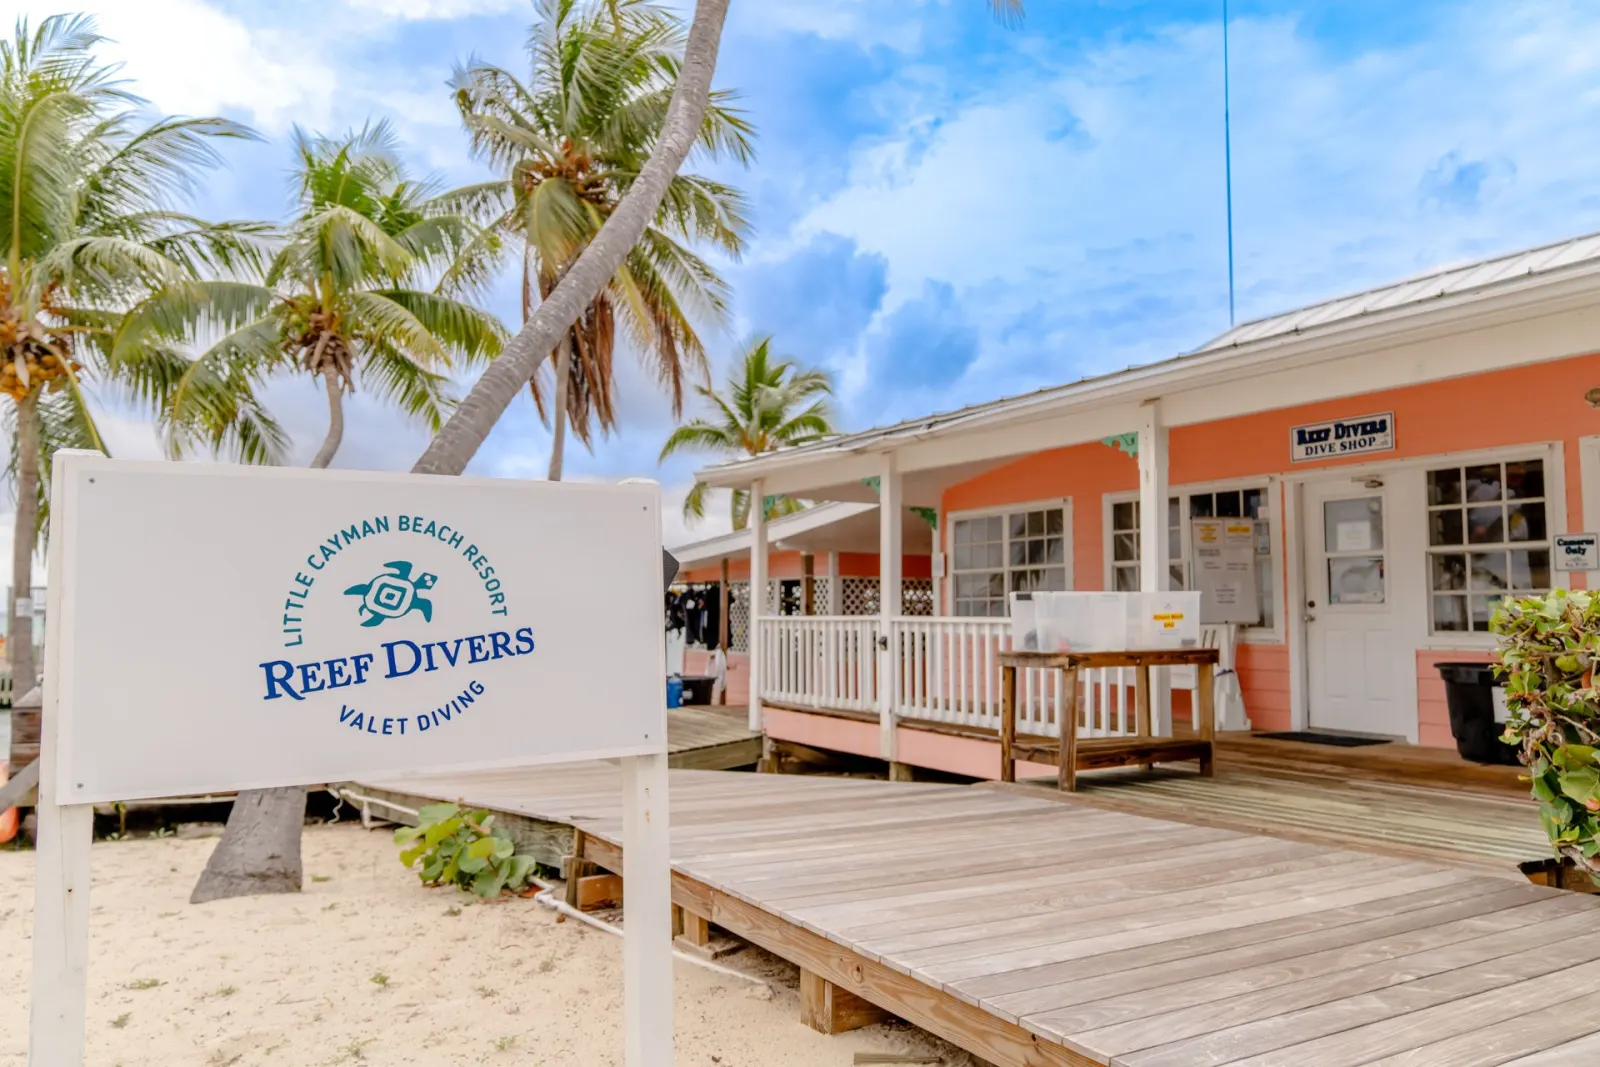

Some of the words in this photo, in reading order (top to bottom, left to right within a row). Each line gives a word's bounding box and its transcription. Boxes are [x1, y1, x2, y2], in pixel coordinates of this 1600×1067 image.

[1305, 443, 1337, 456] DIVE
[1340, 436, 1376, 451] SHOP
[283, 572, 314, 647] LITTLE
[307, 515, 390, 570] CAYMAN
[398, 515, 464, 549] BEACH
[462, 544, 508, 616] RESORT
[258, 653, 374, 701] REEF
[380, 627, 536, 679] DIVERS
[339, 704, 409, 735] VALET
[416, 680, 486, 732] DIVING
